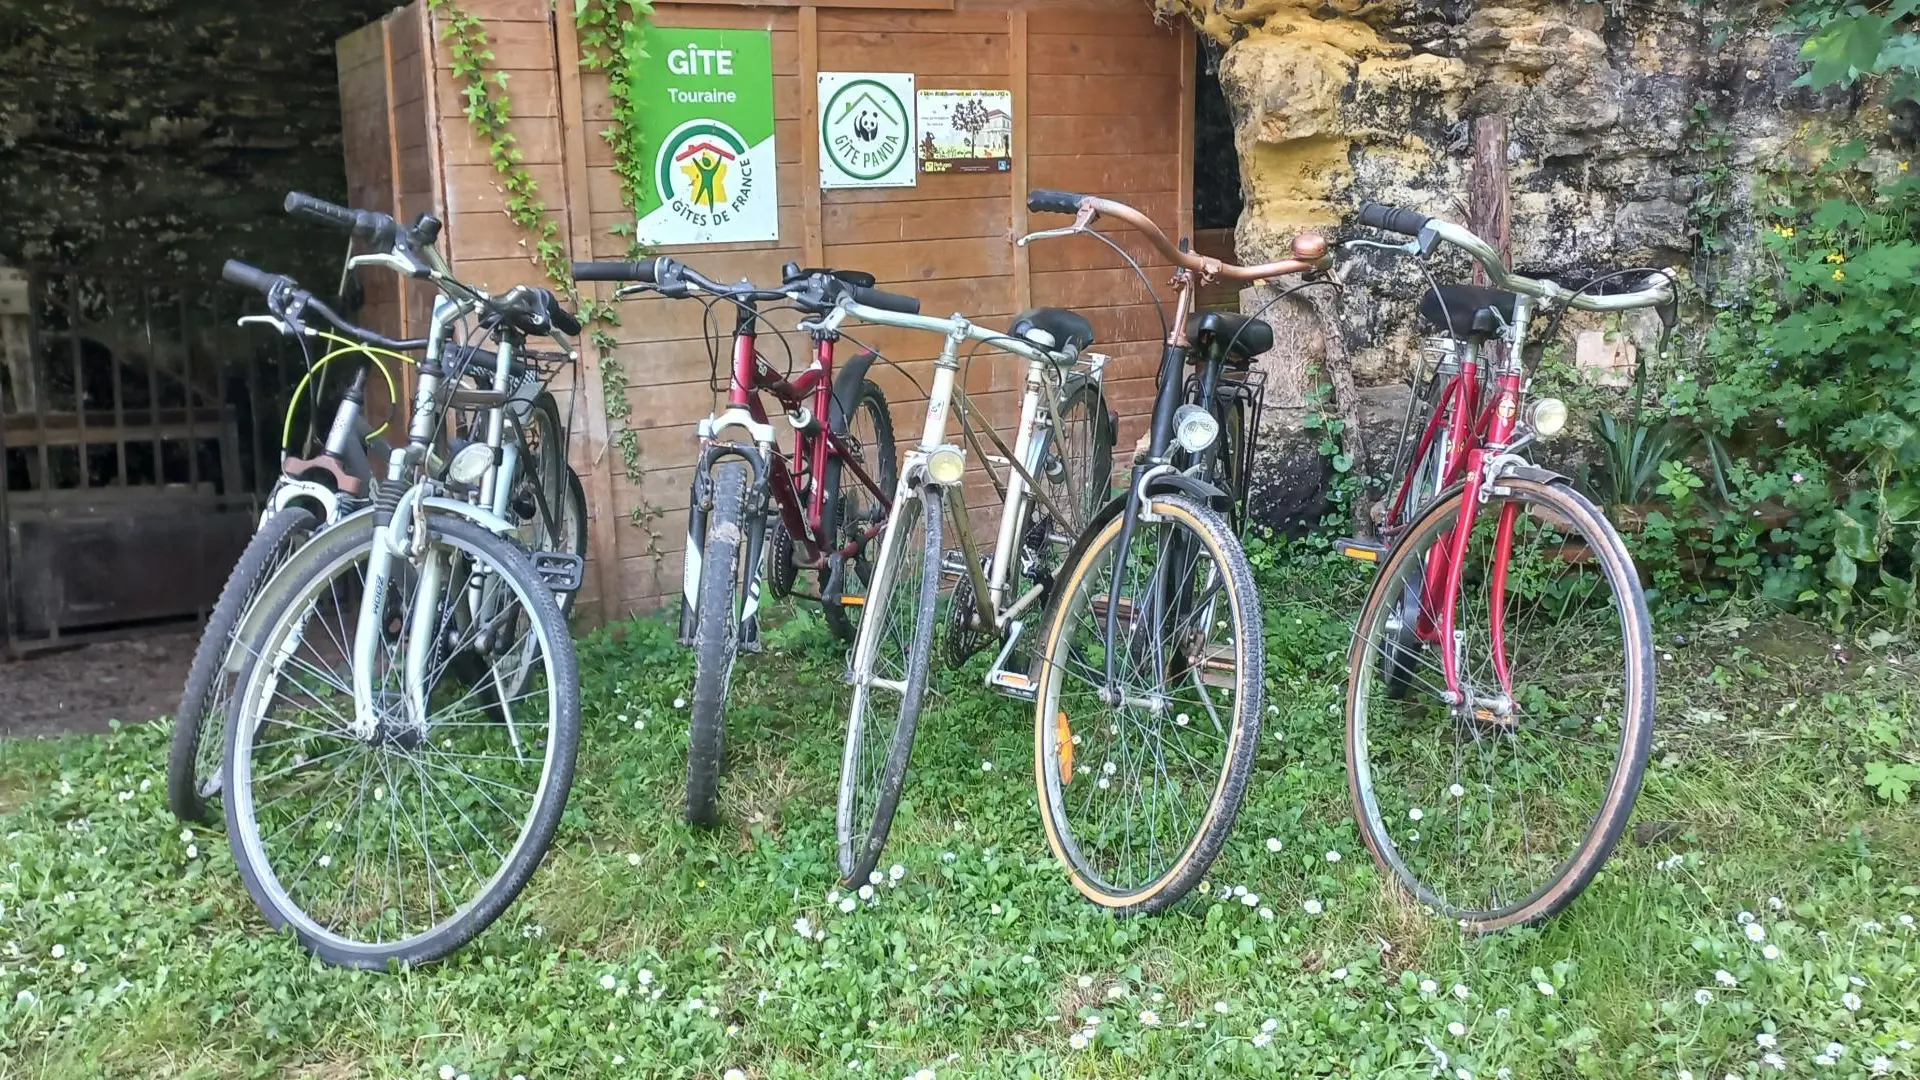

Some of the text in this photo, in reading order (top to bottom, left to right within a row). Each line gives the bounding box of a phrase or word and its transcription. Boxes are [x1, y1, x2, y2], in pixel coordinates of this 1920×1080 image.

[667, 42, 734, 76] GÎTE
[667, 87, 737, 104] Touraine
[835, 134, 900, 168] GÎTE PANDA
[672, 158, 753, 226] GÎTES DE FRANCE
[372, 574, 384, 615] ZOOM
